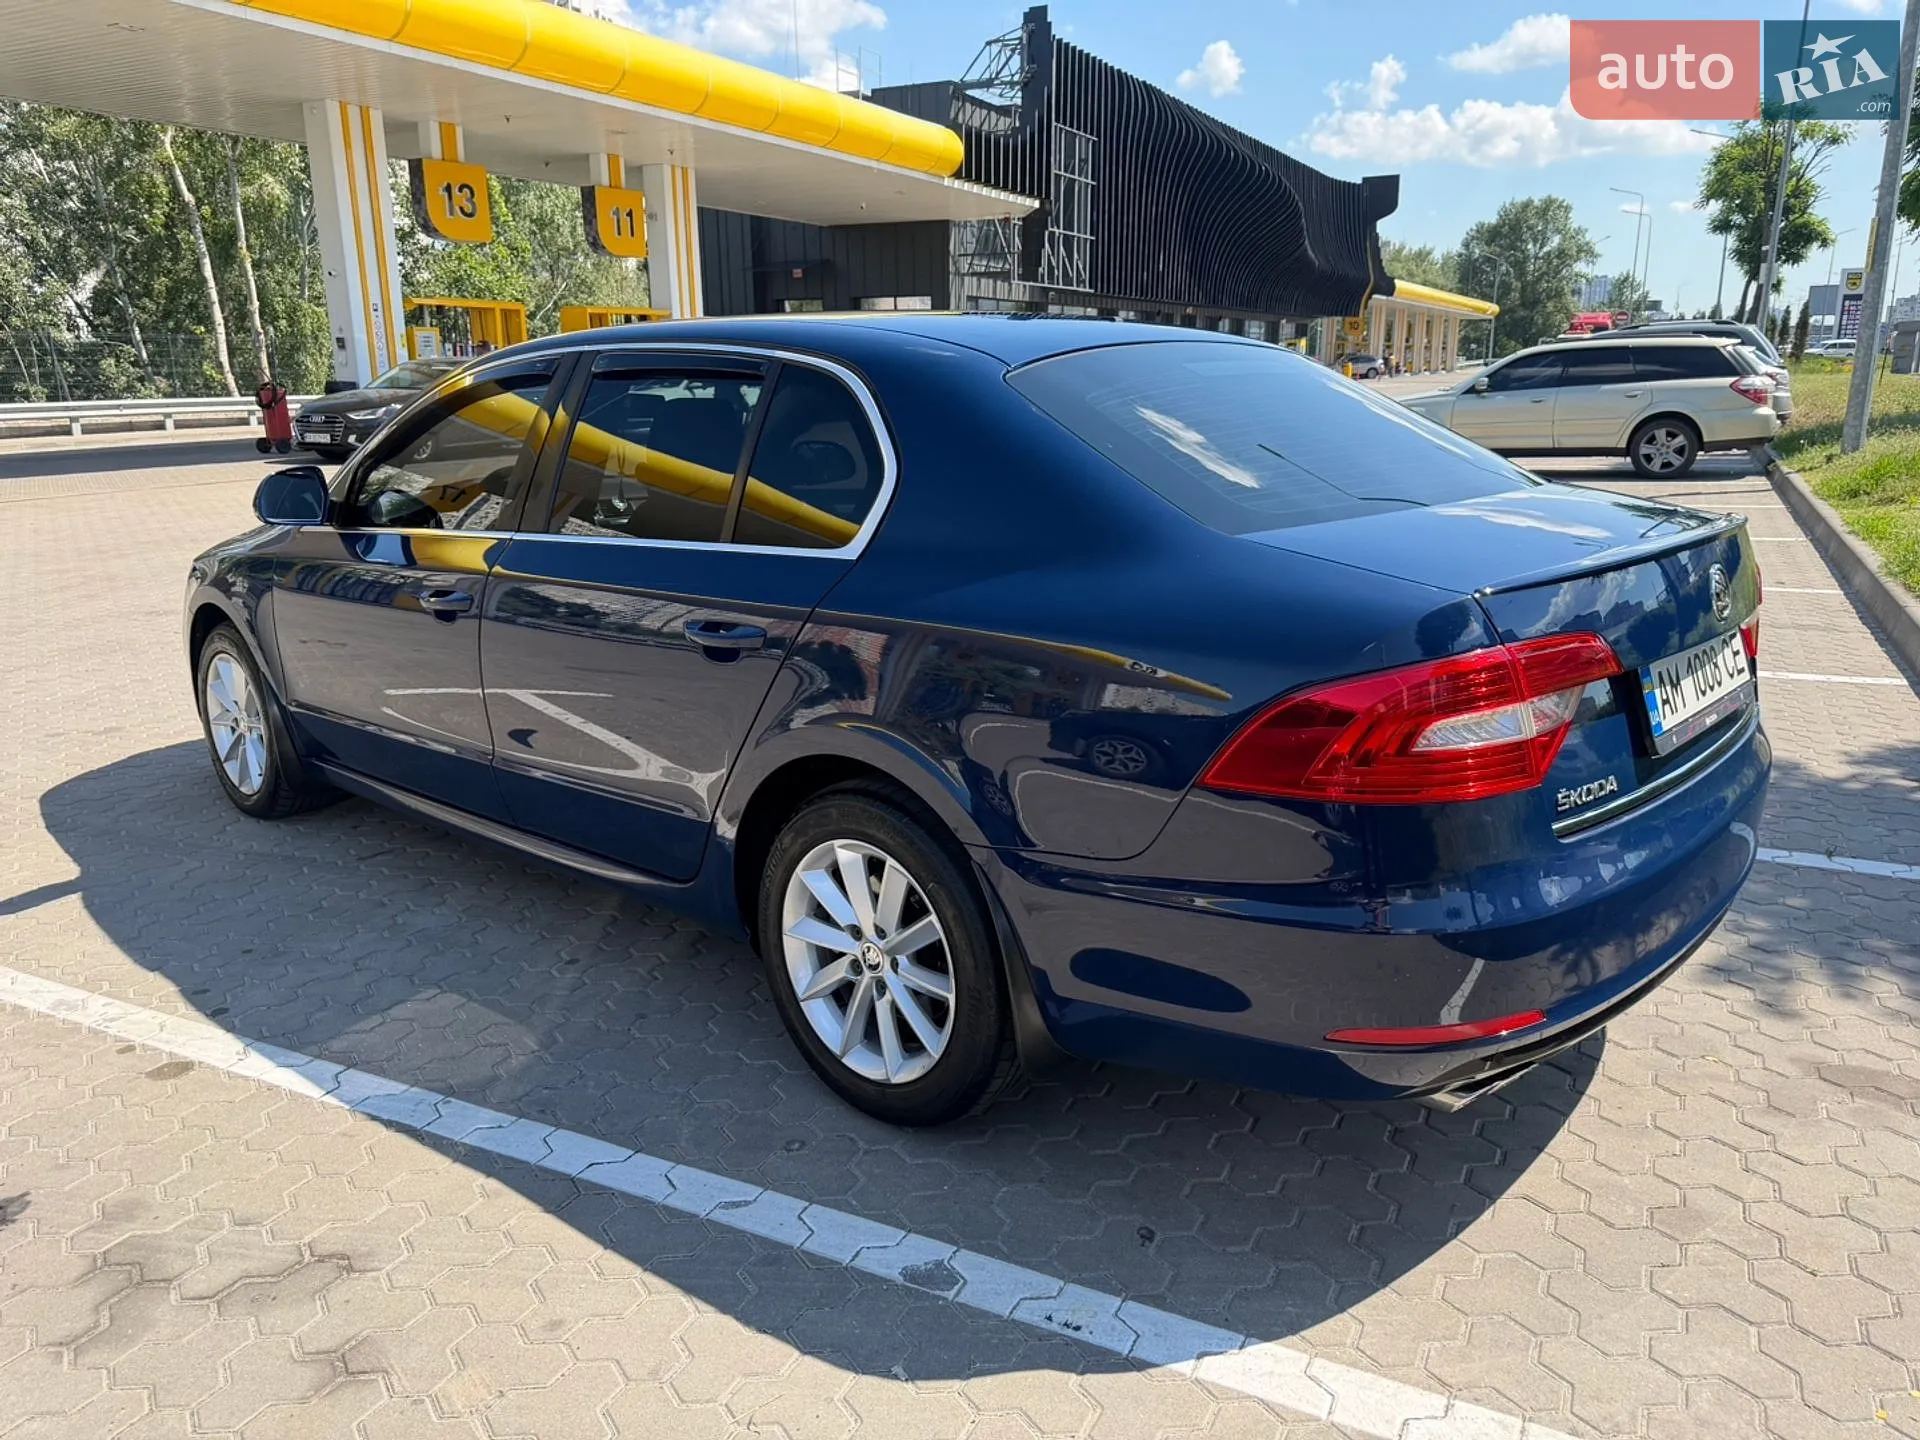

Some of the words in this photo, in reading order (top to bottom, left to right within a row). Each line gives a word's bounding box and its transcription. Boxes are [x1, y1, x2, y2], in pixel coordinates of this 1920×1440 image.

[439, 181, 478, 221] 13
[610, 206, 635, 238] 11
[1348, 320, 1360, 331] 10
[1657, 663, 1686, 720] AM
[1721, 632, 1745, 679] CE
[1557, 775, 1618, 811] ŠKODA
